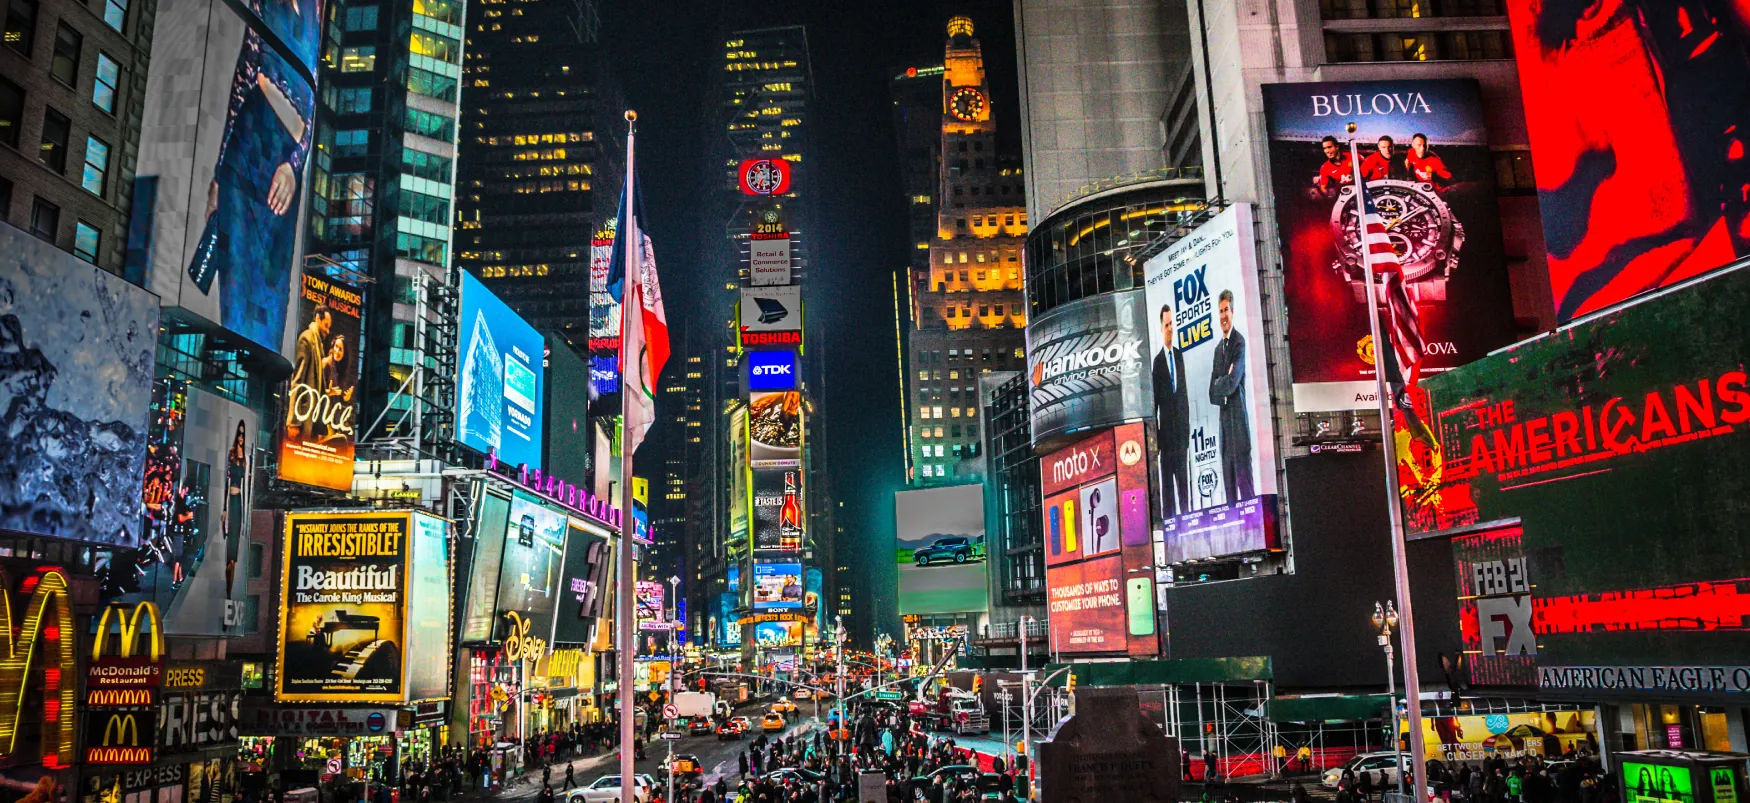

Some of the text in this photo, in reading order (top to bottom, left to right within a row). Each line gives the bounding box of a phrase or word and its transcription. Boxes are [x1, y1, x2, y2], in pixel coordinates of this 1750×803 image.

[1311, 92, 1432, 117] BULOVA
[757, 223, 783, 233] 2014
[1168, 250, 1179, 262] MEET
[1164, 268, 1173, 278] GOT
[1173, 260, 1185, 271] SOME
[307, 275, 329, 292] TONY
[329, 285, 362, 306] AWARDS
[1173, 264, 1210, 313] FOX
[306, 289, 360, 319] BEST MUSICAL
[1175, 297, 1211, 326] SPORTS
[741, 331, 801, 344] TOSHIBA
[1179, 319, 1211, 348] LIVE
[761, 364, 791, 375] TDK
[1053, 360, 1143, 386] driving emotion
[1475, 399, 1516, 430] THE
[1053, 445, 1101, 483] moto X
[1194, 448, 1217, 463] NIGHTLY
[1201, 472, 1214, 486] FOX
[393, 490, 419, 498] LAMAR
[329, 523, 346, 533] JOINS
[347, 523, 358, 533] THE
[359, 523, 379, 533] RANKS
[380, 522, 387, 532] OF
[387, 522, 400, 532] THE
[296, 564, 397, 590] Beautiful
[1473, 556, 1530, 596] FEB 21
[296, 592, 396, 605] The Carole King Musical
[1051, 579, 1118, 599] THOUSANDS OF WAYS TO
[1051, 593, 1121, 612] CUSTOMIZE YOUR PHONE.
[1477, 595, 1538, 657] FX
[89, 665, 159, 677] McDonald's
[165, 668, 205, 688] PRESS
[1541, 667, 1646, 689] AMERICAN
[1650, 667, 1726, 691] EAGLE
[993, 692, 1014, 702] VORDO
[257, 709, 348, 722] DIGITAL
[1437, 743, 1452, 751] GET
[1453, 743, 1470, 751] TWO
[1524, 739, 1542, 748] ERS
[1446, 751, 1485, 761] CLOSER
